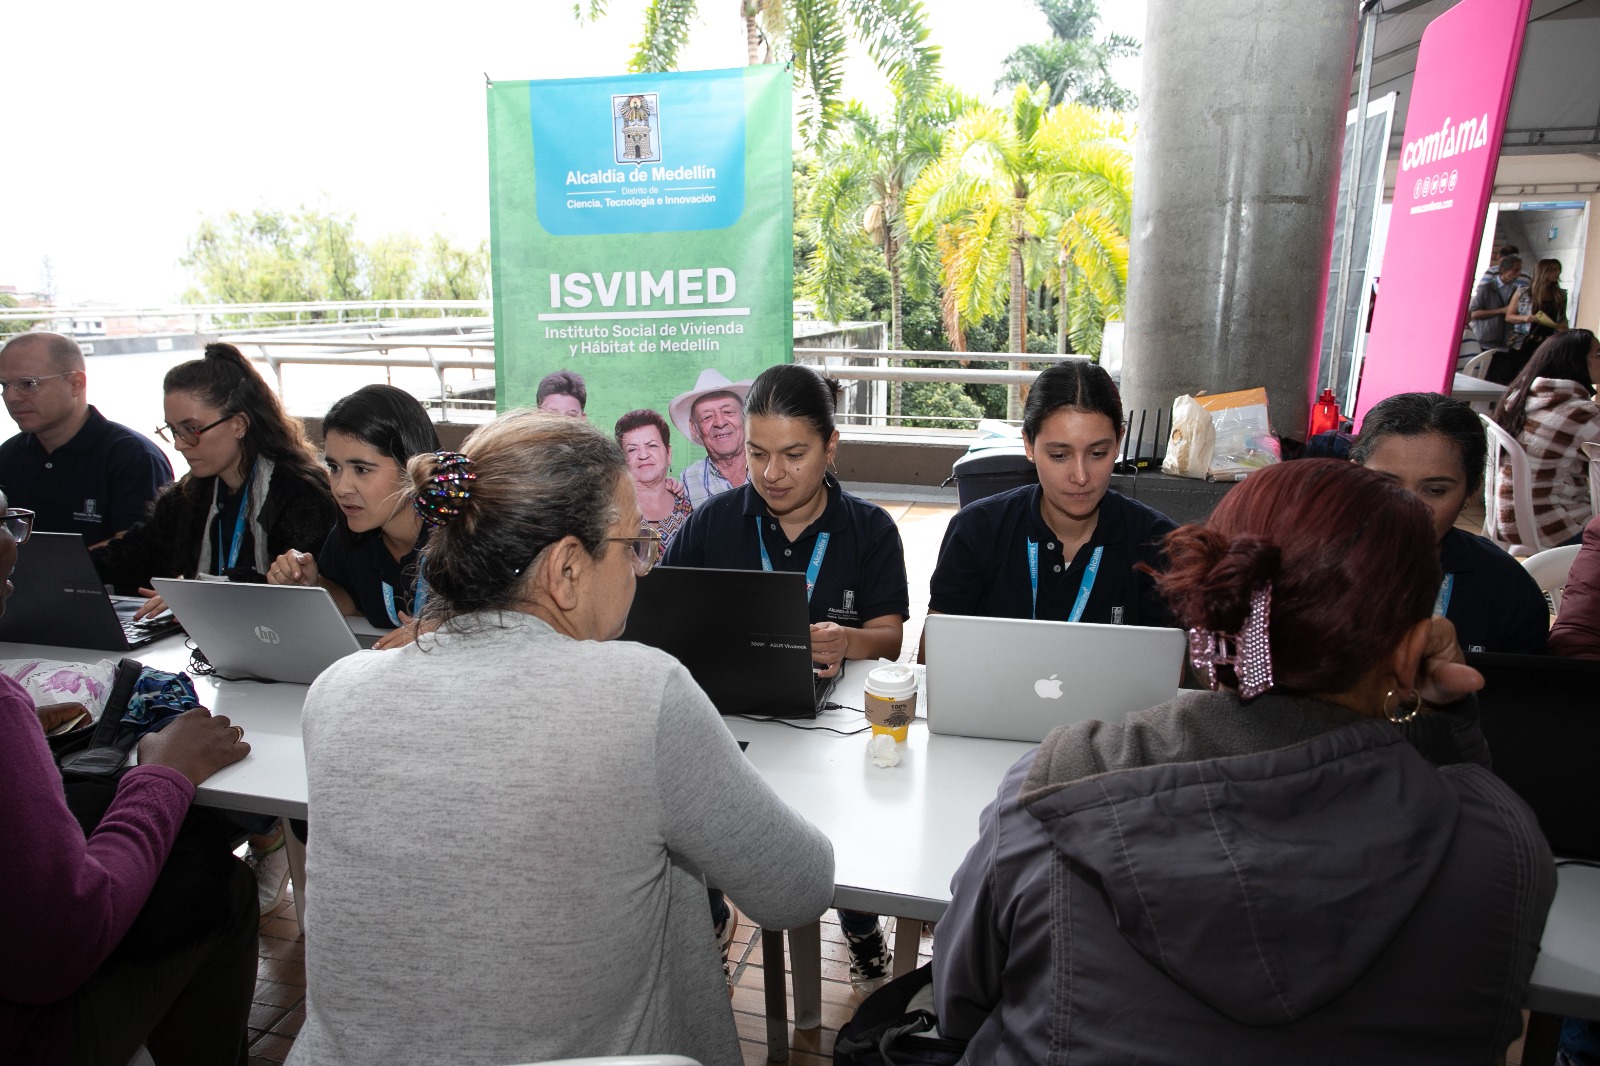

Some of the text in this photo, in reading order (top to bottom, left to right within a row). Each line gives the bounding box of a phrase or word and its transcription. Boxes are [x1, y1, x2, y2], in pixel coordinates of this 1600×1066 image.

[1402, 113, 1488, 172] comfama
[566, 165, 716, 185] Alcaldía de Medellín
[621, 186, 659, 195] Distrito de
[566, 199, 603, 209] Ciencia,
[605, 197, 655, 208] Tecnología
[665, 193, 716, 204] Innovación
[549, 267, 737, 308] ISVIMED
[545, 321, 744, 339] Instituto Social de Vivienda
[569, 337, 720, 357] y Hábitat de Medellín
